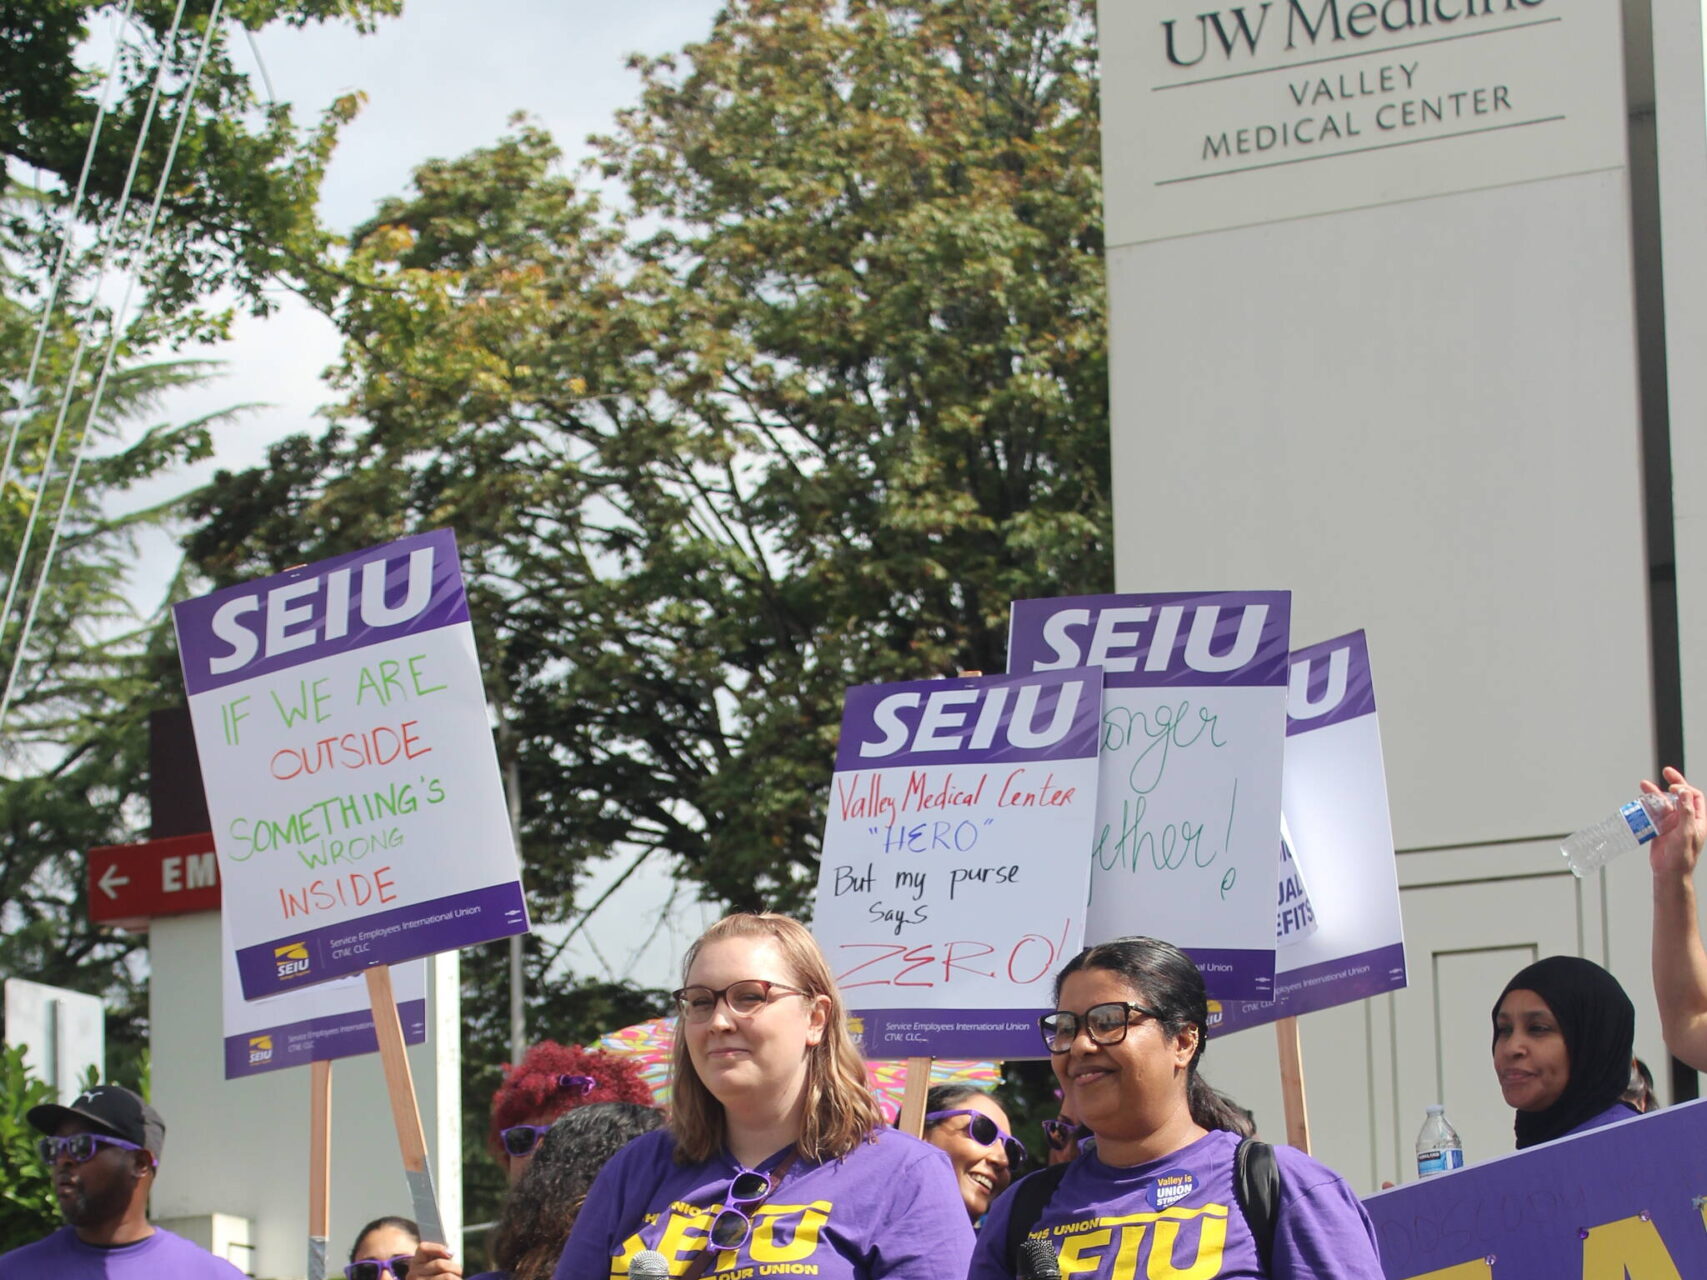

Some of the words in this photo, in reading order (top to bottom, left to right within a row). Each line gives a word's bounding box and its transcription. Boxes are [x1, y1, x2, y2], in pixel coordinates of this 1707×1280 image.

[1161, 2, 1273, 67] UW
[1284, 0, 1545, 51] Medici
[1288, 61, 1419, 106] VALLEY
[1202, 111, 1361, 160] MEDICAL
[1375, 84, 1513, 132] CENTER
[209, 547, 434, 675] SEIU
[1032, 606, 1270, 673] SEIU
[221, 696, 251, 745] IF
[270, 677, 333, 729] WE
[356, 654, 448, 706] ARE
[859, 680, 1084, 758] SEIU
[270, 720, 432, 780] OUTSIDE
[228, 775, 445, 862] SOMETHING'S
[838, 772, 896, 825] Valley
[901, 771, 987, 813] Medical
[998, 768, 1076, 808] Center
[297, 827, 404, 869] WRONG
[1089, 778, 1237, 905] ether!
[279, 866, 397, 919] INSIDE
[833, 863, 877, 897] But
[895, 869, 926, 901] my
[950, 864, 1020, 900] purse
[358, 923, 401, 941] Employees
[402, 911, 453, 930] International
[454, 905, 481, 918] Union
[277, 958, 309, 977] SEIU
[1206, 963, 1233, 972] Union
[913, 1022, 955, 1032] Employees
[955, 1022, 1004, 1031] International
[1005, 1022, 1030, 1031] Union
[1157, 1175, 1184, 1187] Valley
[1184, 1174, 1193, 1183] is
[1157, 1183, 1193, 1198] UNION
[1053, 1217, 1100, 1236] UNION
[759, 1263, 819, 1277] UNION
